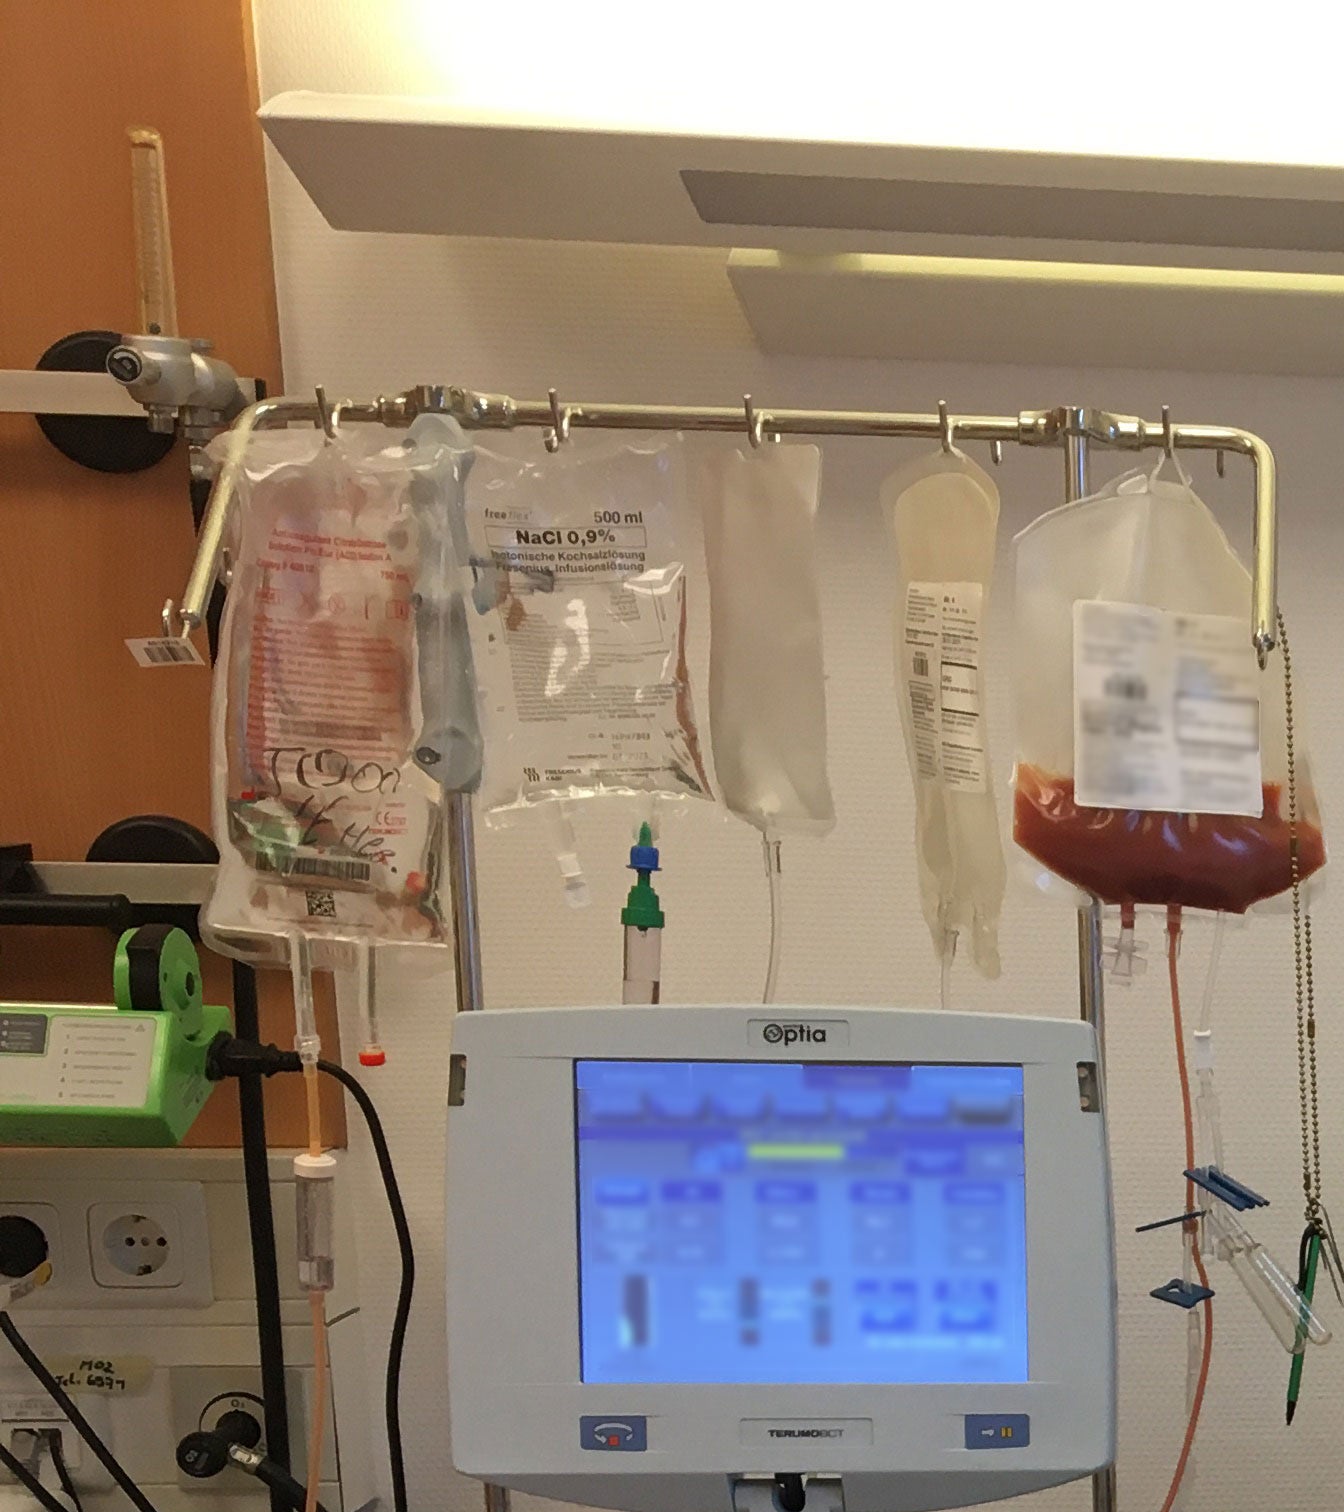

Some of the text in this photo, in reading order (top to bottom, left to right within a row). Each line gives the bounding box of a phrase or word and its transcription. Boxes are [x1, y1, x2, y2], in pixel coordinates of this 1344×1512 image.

[594, 510, 643, 524] 500 ml
[516, 528, 616, 547] NaCl 0,9%
[558, 550, 645, 562] Kochsalzlösung
[555, 561, 645, 573] Infusionslösung
